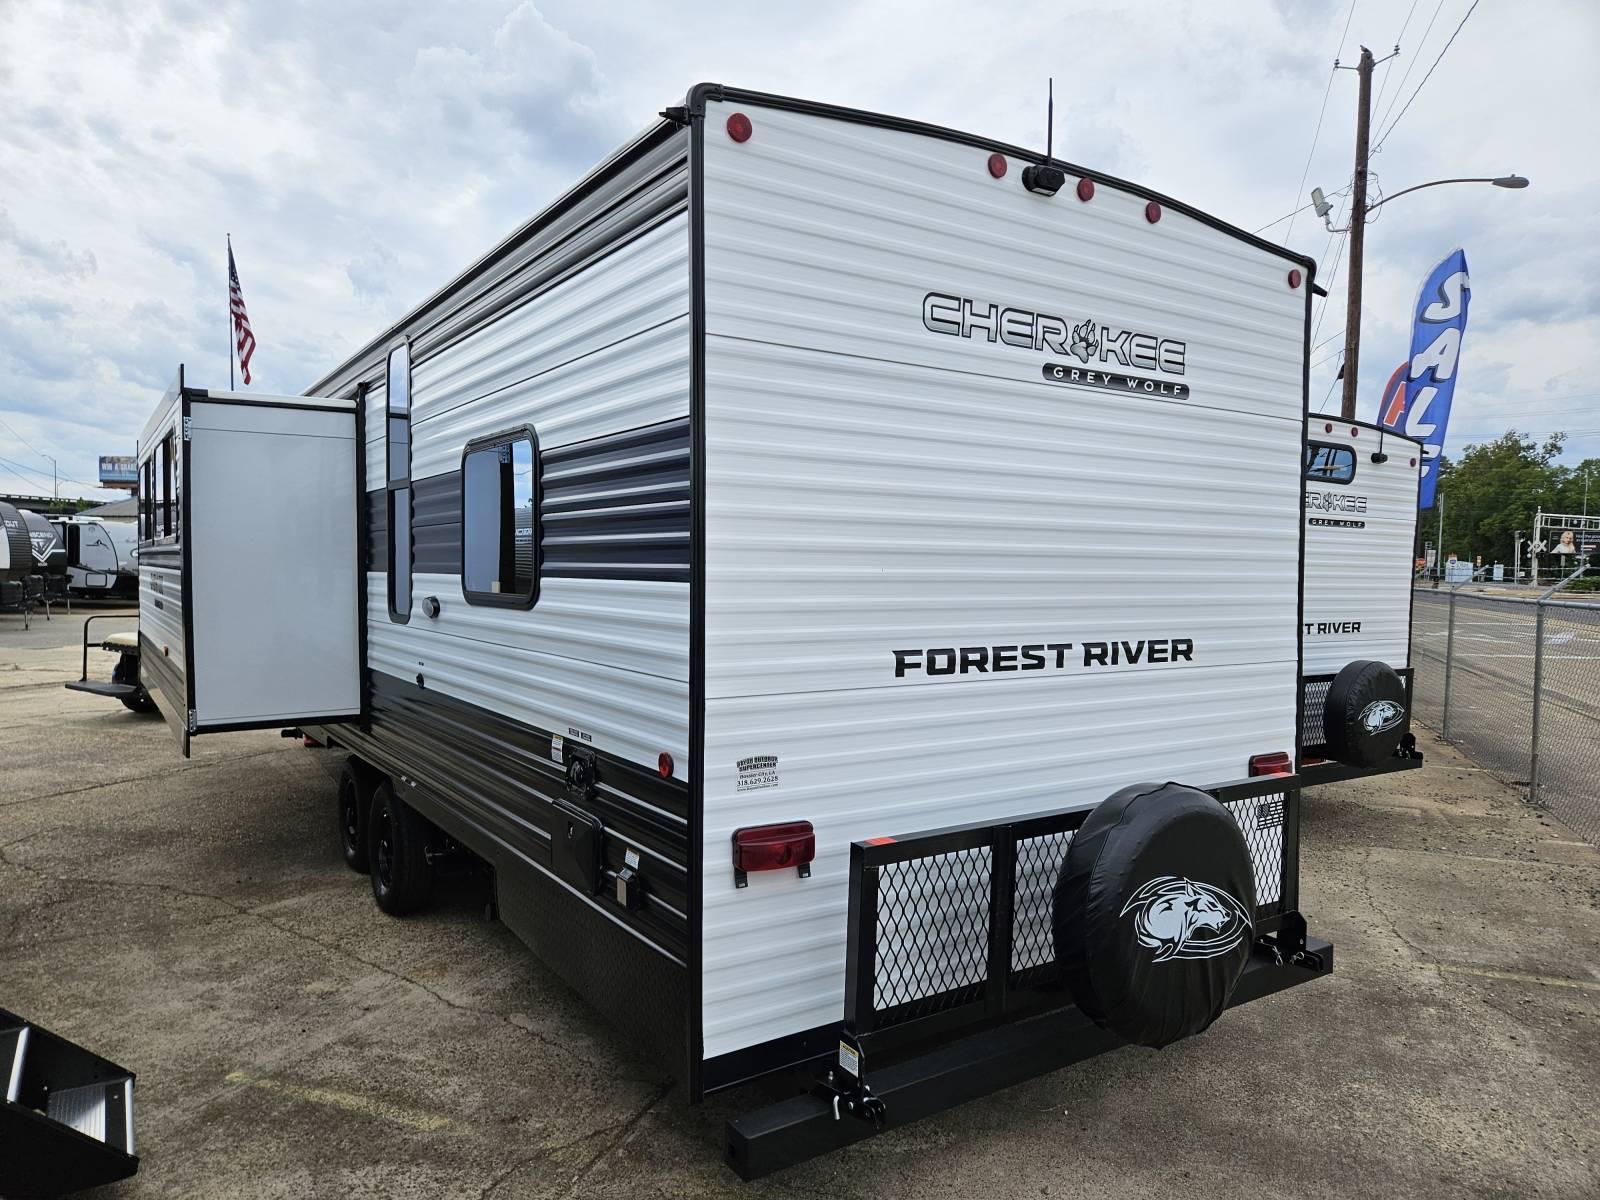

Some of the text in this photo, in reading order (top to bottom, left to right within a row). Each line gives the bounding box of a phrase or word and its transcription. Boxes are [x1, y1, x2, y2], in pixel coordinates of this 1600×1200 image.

[1053, 365, 1182, 396] GREY WOLF
[1317, 621, 1361, 635] RIVER
[892, 638, 1194, 678] FOREST RIVER
